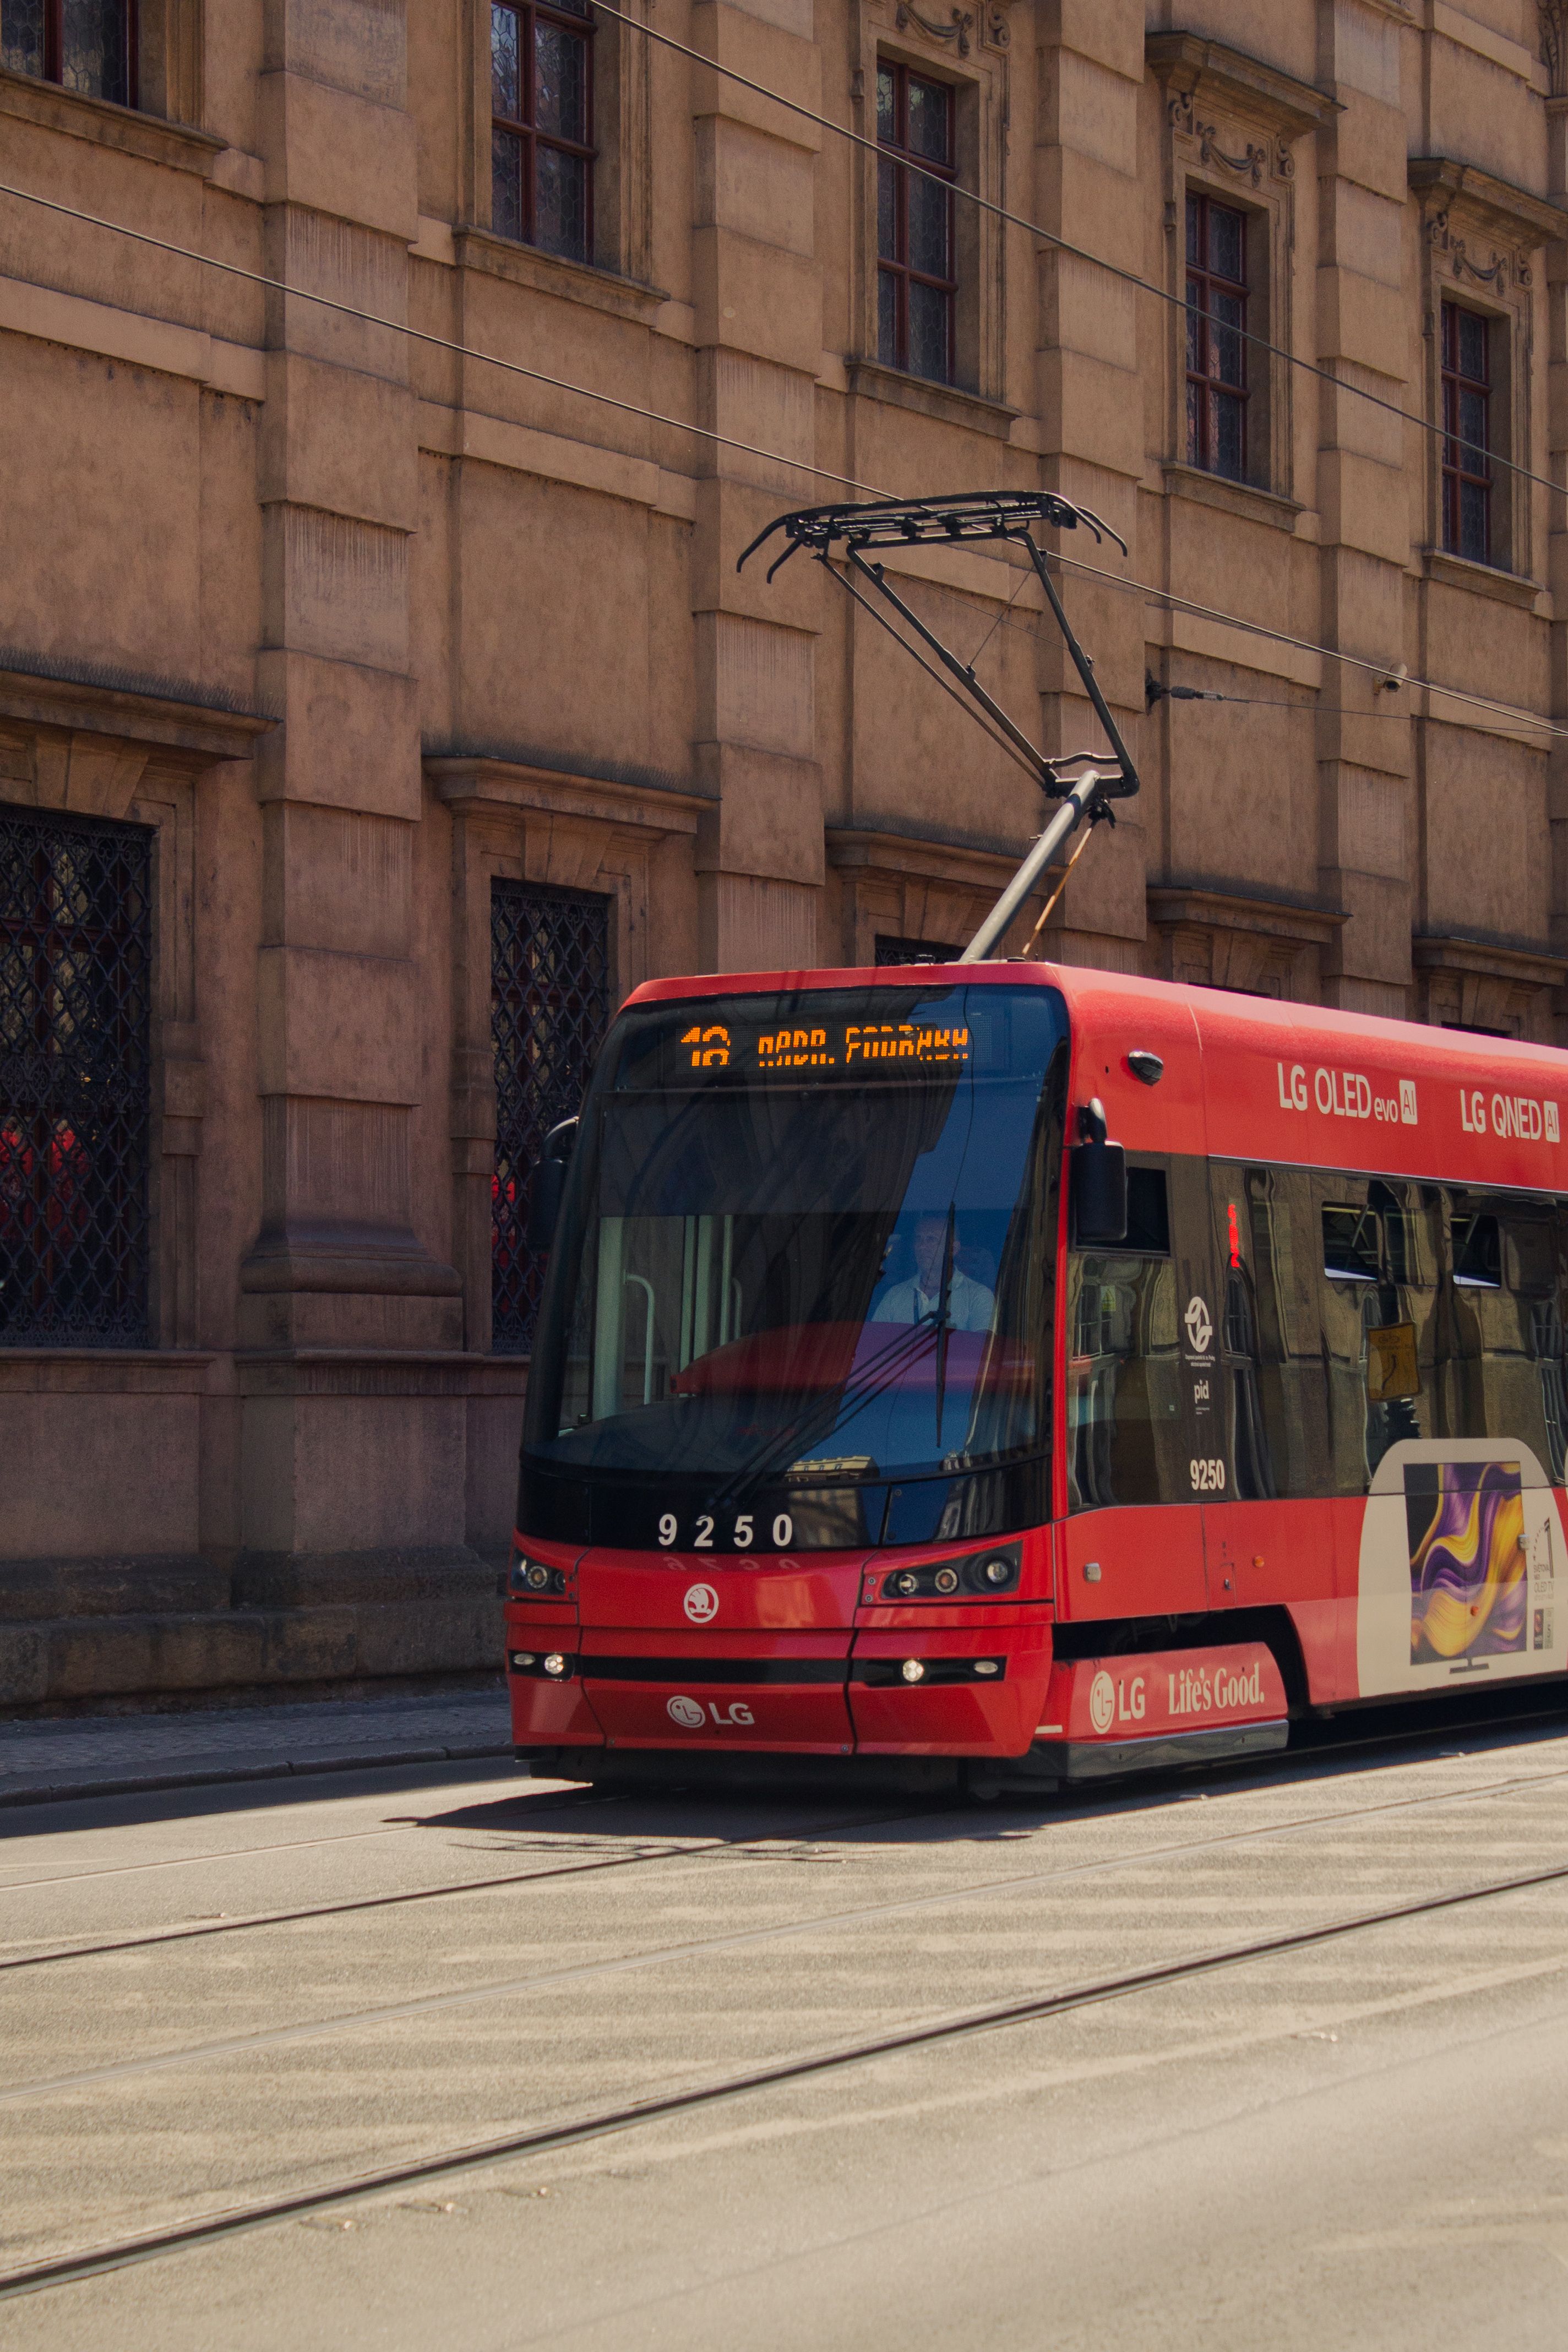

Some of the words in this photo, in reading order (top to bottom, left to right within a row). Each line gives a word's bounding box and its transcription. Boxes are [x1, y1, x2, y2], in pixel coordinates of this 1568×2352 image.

[1277, 1062, 1308, 1111] LG
[1314, 1068, 1371, 1119] OLED
[1374, 1097, 1398, 1123] evo
[1402, 1086, 1417, 1119] AI
[1460, 1089, 1487, 1134] LG
[1491, 1093, 1542, 1140] QNED
[1194, 1379, 1210, 1404] pid
[1190, 1459, 1226, 1490] 9250
[1118, 1676, 1146, 1721] LG
[1168, 1667, 1212, 1715] Life's
[1213, 1662, 1265, 1709] Good.
[709, 1702, 755, 1725] LG
